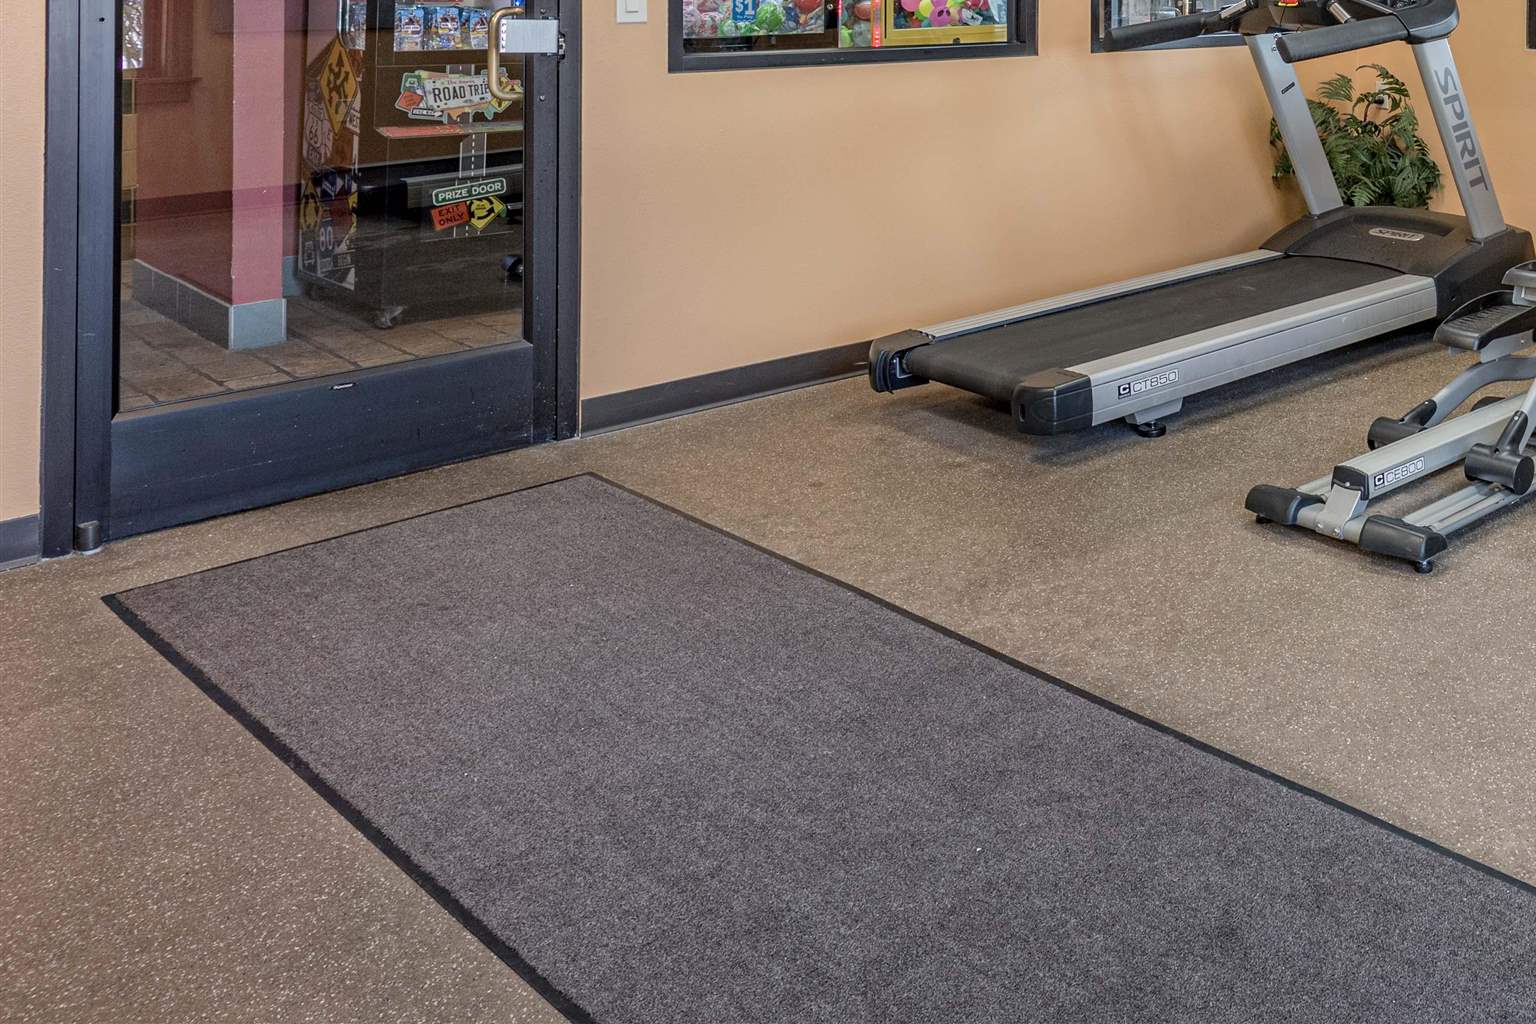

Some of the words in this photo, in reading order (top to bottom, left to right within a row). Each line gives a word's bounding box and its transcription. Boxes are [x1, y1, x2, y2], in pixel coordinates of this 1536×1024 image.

[432, 85, 466, 103] ROAD
[1434, 66, 1488, 191] SPIRIT
[438, 188, 469, 201] PRIZE
[472, 182, 502, 195] DOOR
[438, 204, 460, 217] EXIT
[439, 212, 464, 226] ONLY
[319, 226, 334, 251] 80
[1132, 370, 1177, 393] CT850
